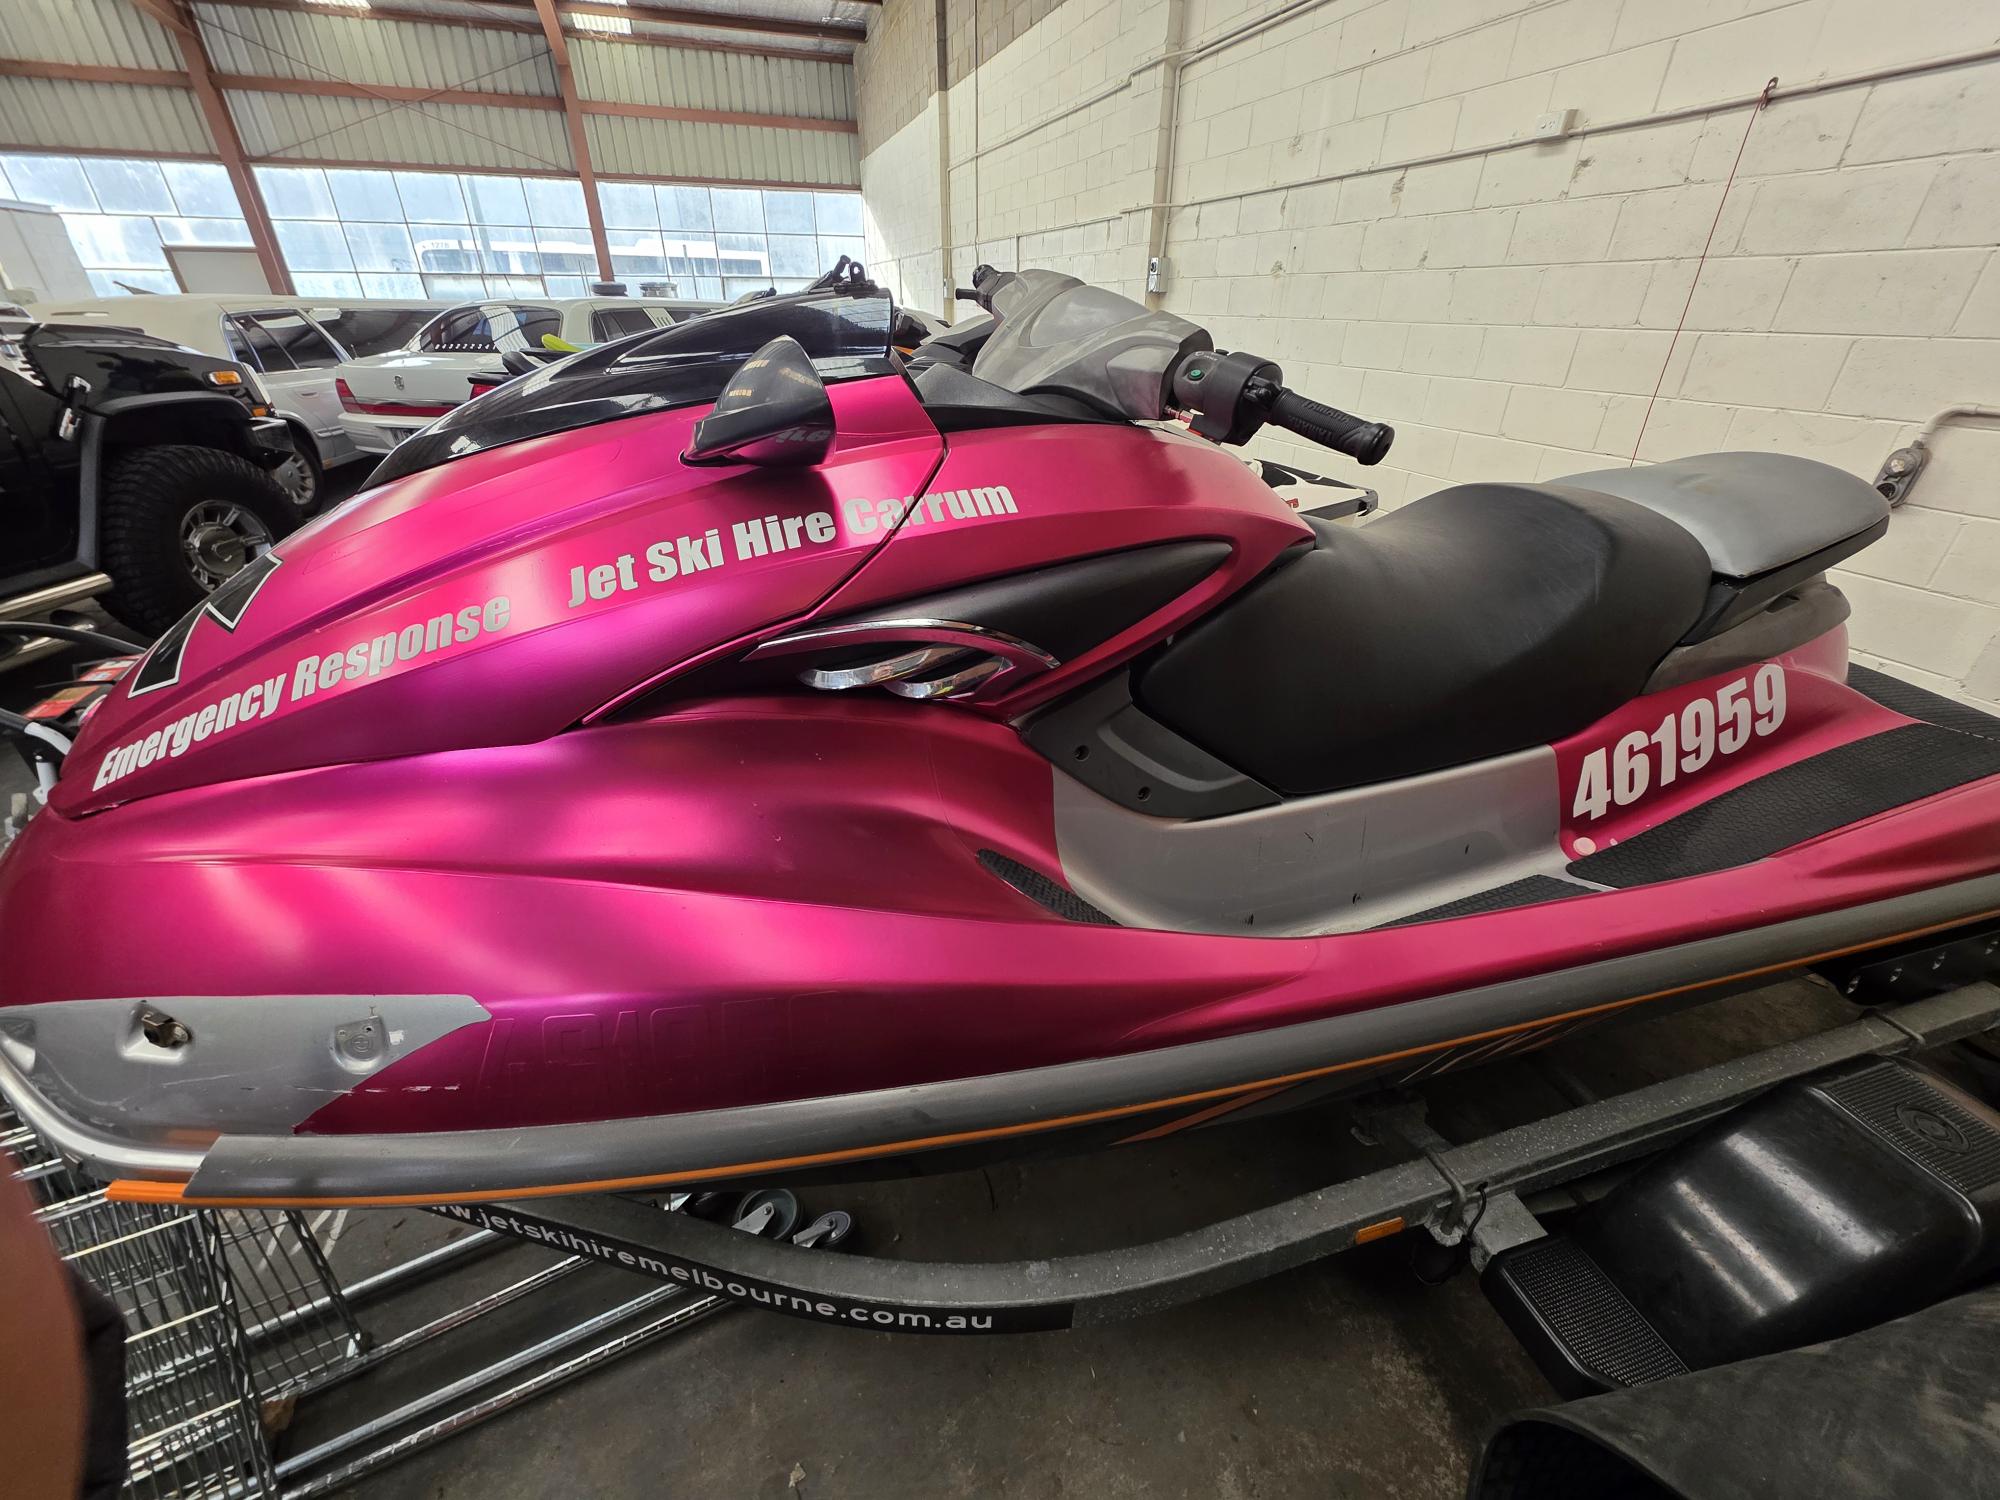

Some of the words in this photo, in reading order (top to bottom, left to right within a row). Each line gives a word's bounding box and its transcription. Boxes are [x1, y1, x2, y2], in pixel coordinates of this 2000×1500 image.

[568, 554, 638, 608] Jet
[646, 529, 724, 582] Ski
[734, 509, 836, 561] Hire
[844, 485, 1018, 535] Carrum
[93, 674, 287, 792] Emergency
[291, 595, 511, 703] Response
[1573, 663, 1787, 821] 461959
